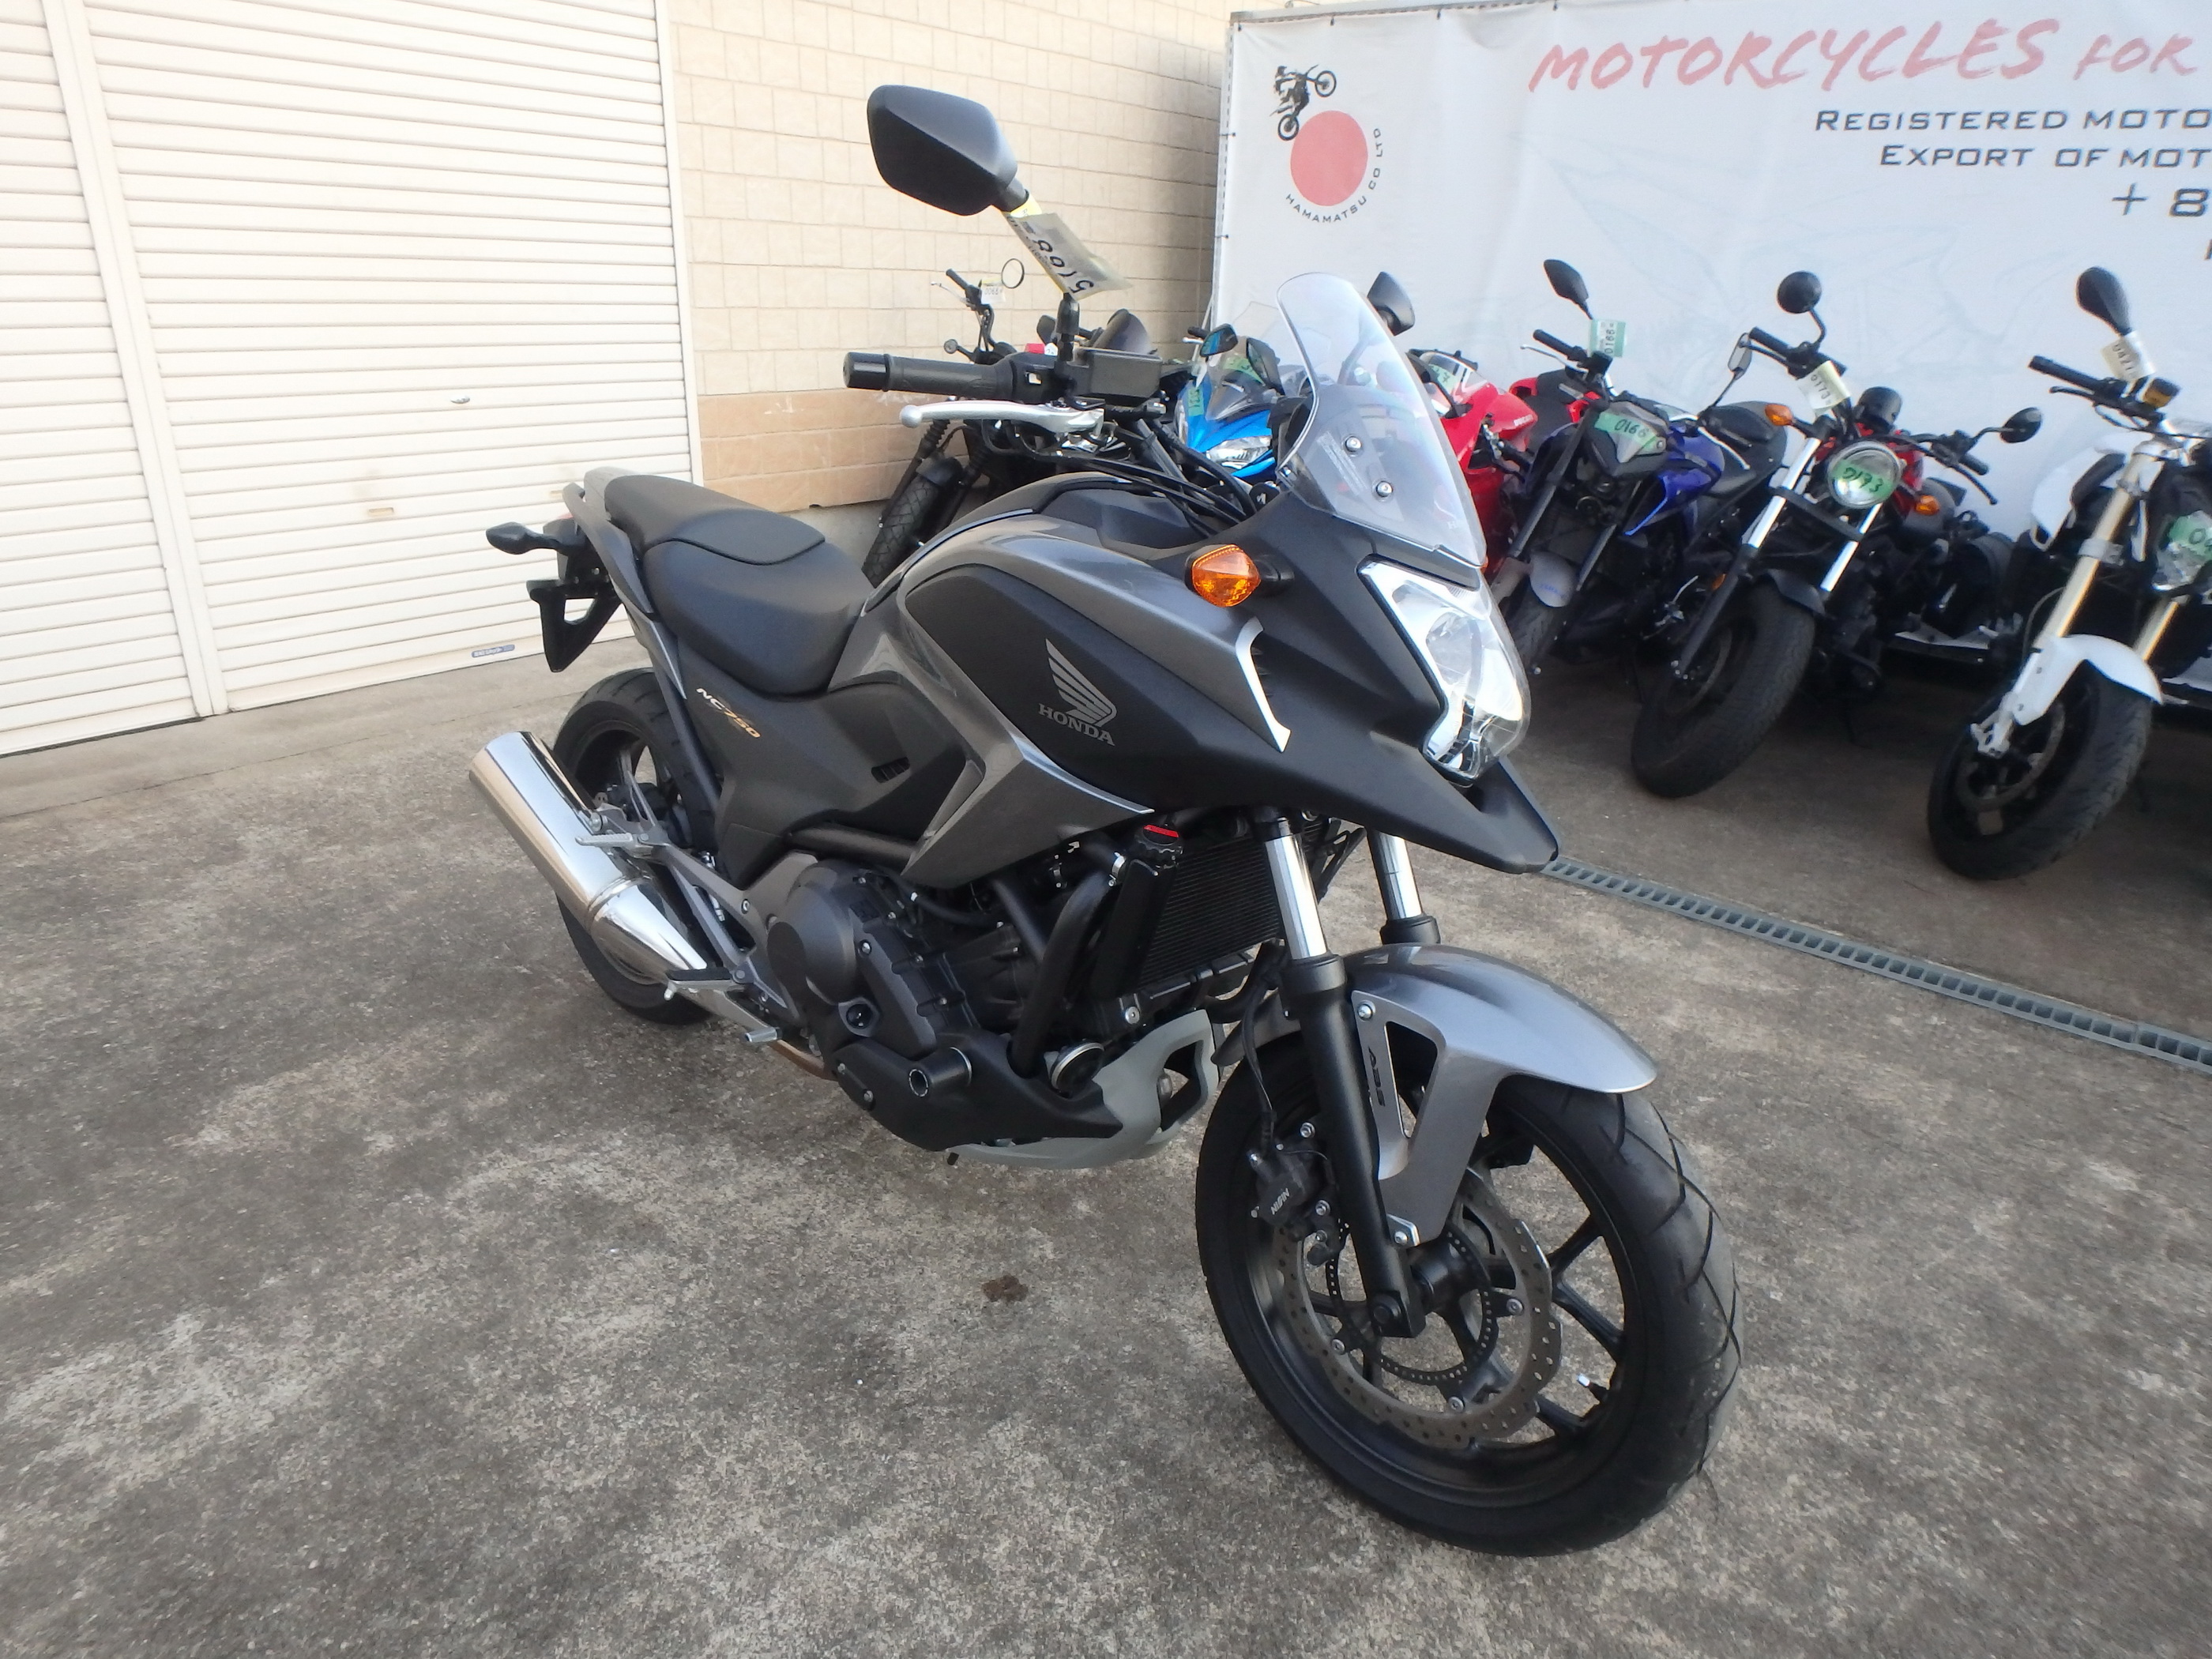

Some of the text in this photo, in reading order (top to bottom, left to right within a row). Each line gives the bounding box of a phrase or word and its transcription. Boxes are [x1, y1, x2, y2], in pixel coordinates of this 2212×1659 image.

[1528, 18, 2199, 92] MOTORCYCLES FOR
[1815, 109, 2068, 131] REGISTERED
[1285, 194, 1367, 224] HAMAMATSU
[1373, 128, 1383, 157] LTD
[1880, 144, 2036, 166] EXPORT
[2055, 148, 2110, 167] OF
[1038, 702, 1115, 747] HONDA
